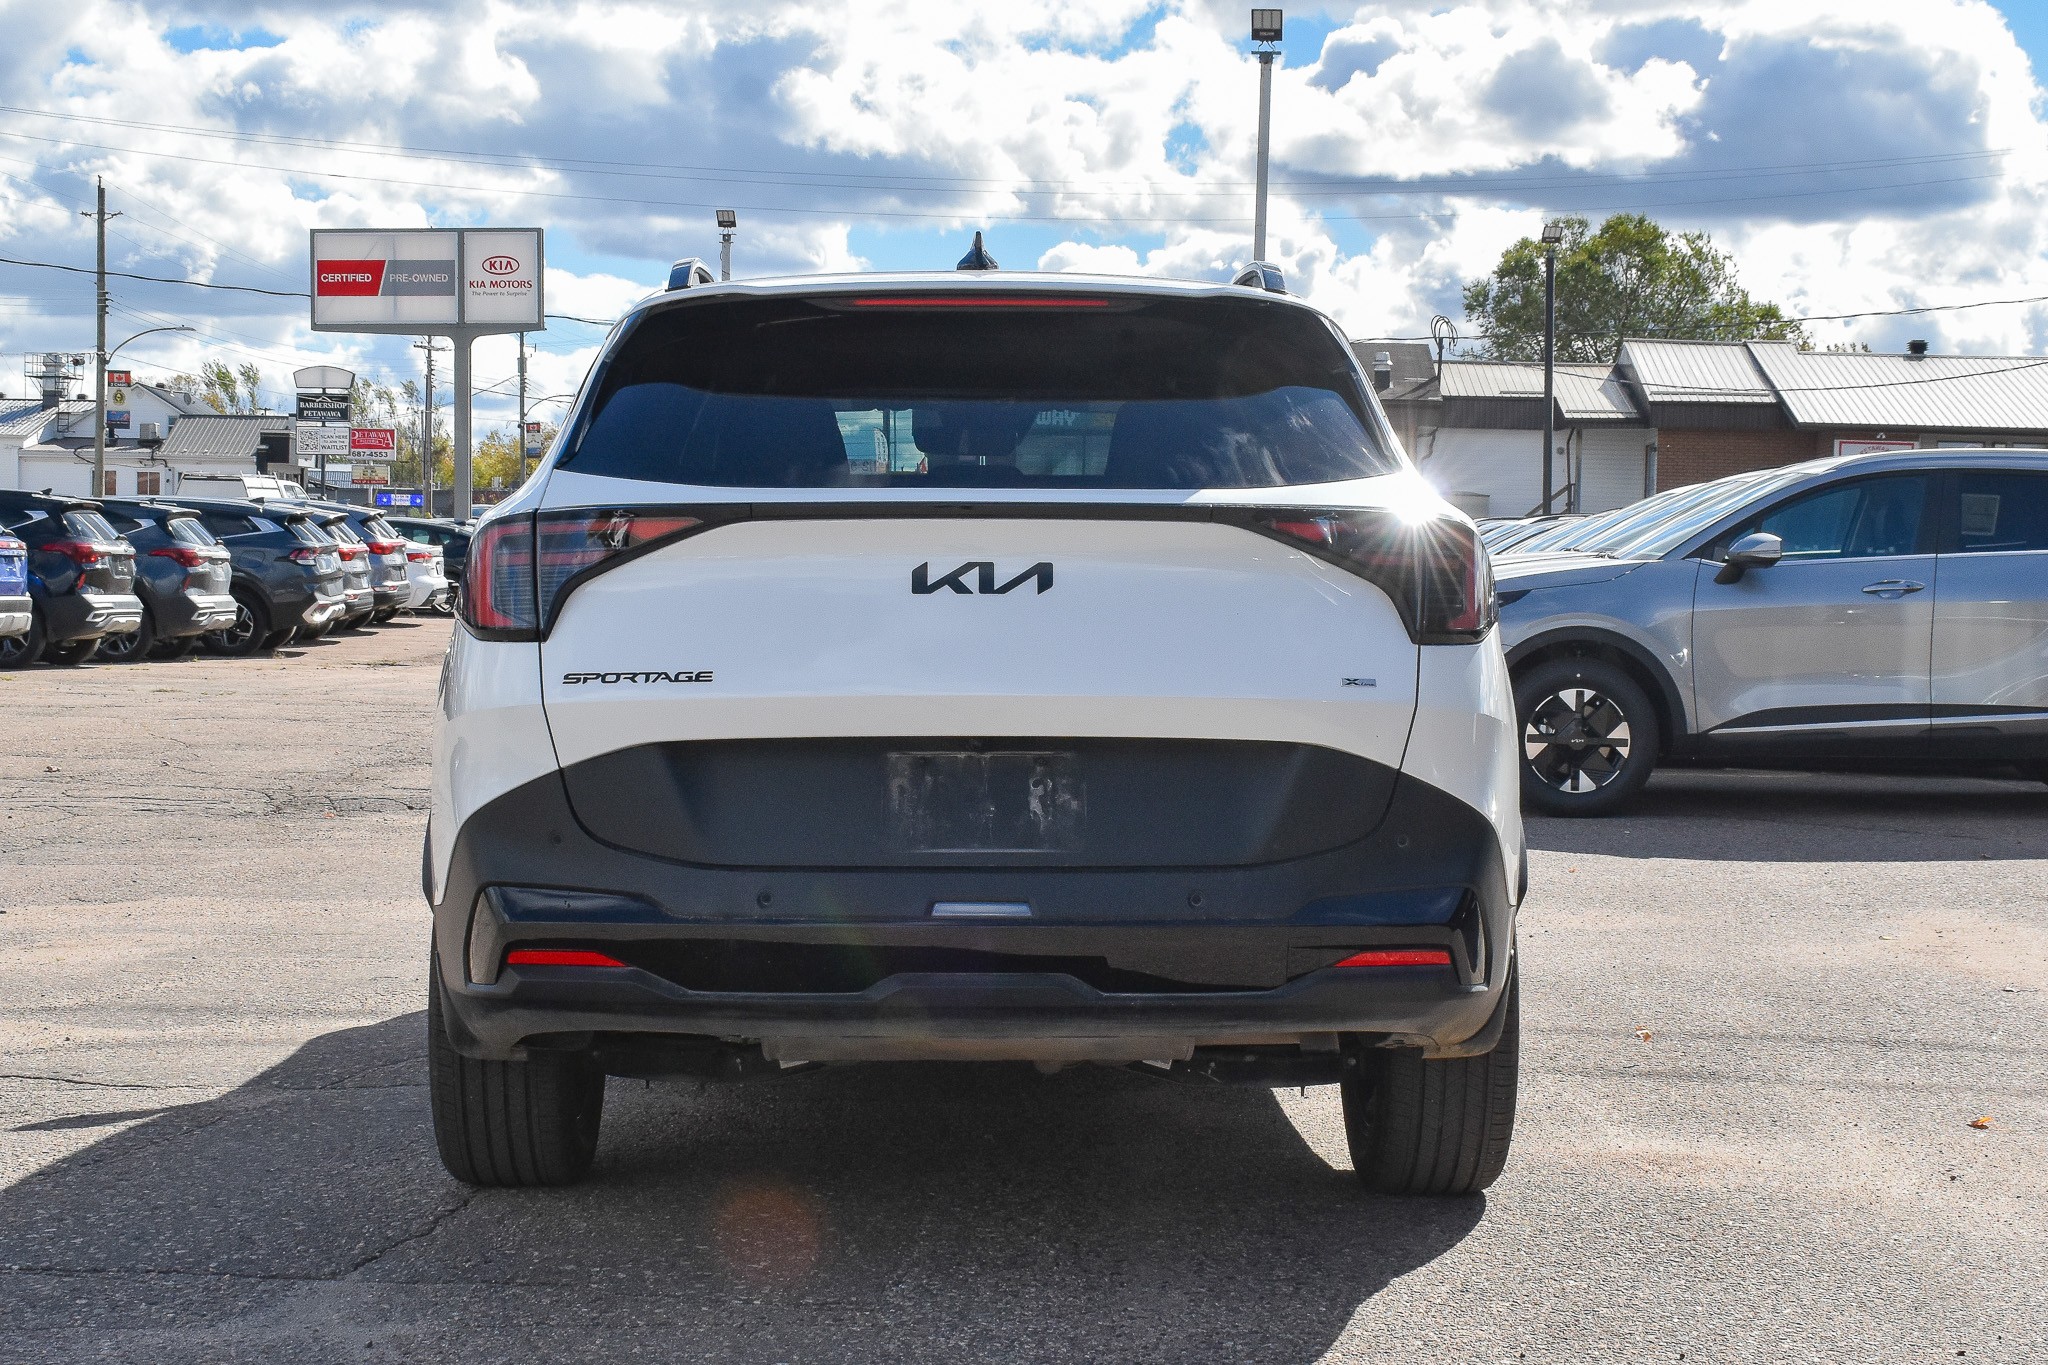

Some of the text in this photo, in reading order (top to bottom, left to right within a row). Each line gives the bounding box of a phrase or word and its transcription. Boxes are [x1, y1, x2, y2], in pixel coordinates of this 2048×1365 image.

[489, 260, 513, 270] KIA
[320, 273, 449, 283] CERTIFIED PRE-OWNED
[469, 280, 532, 288] KIA MOTORS
[911, 561, 1054, 595] KIA
[562, 671, 714, 684] SPORTAGE
